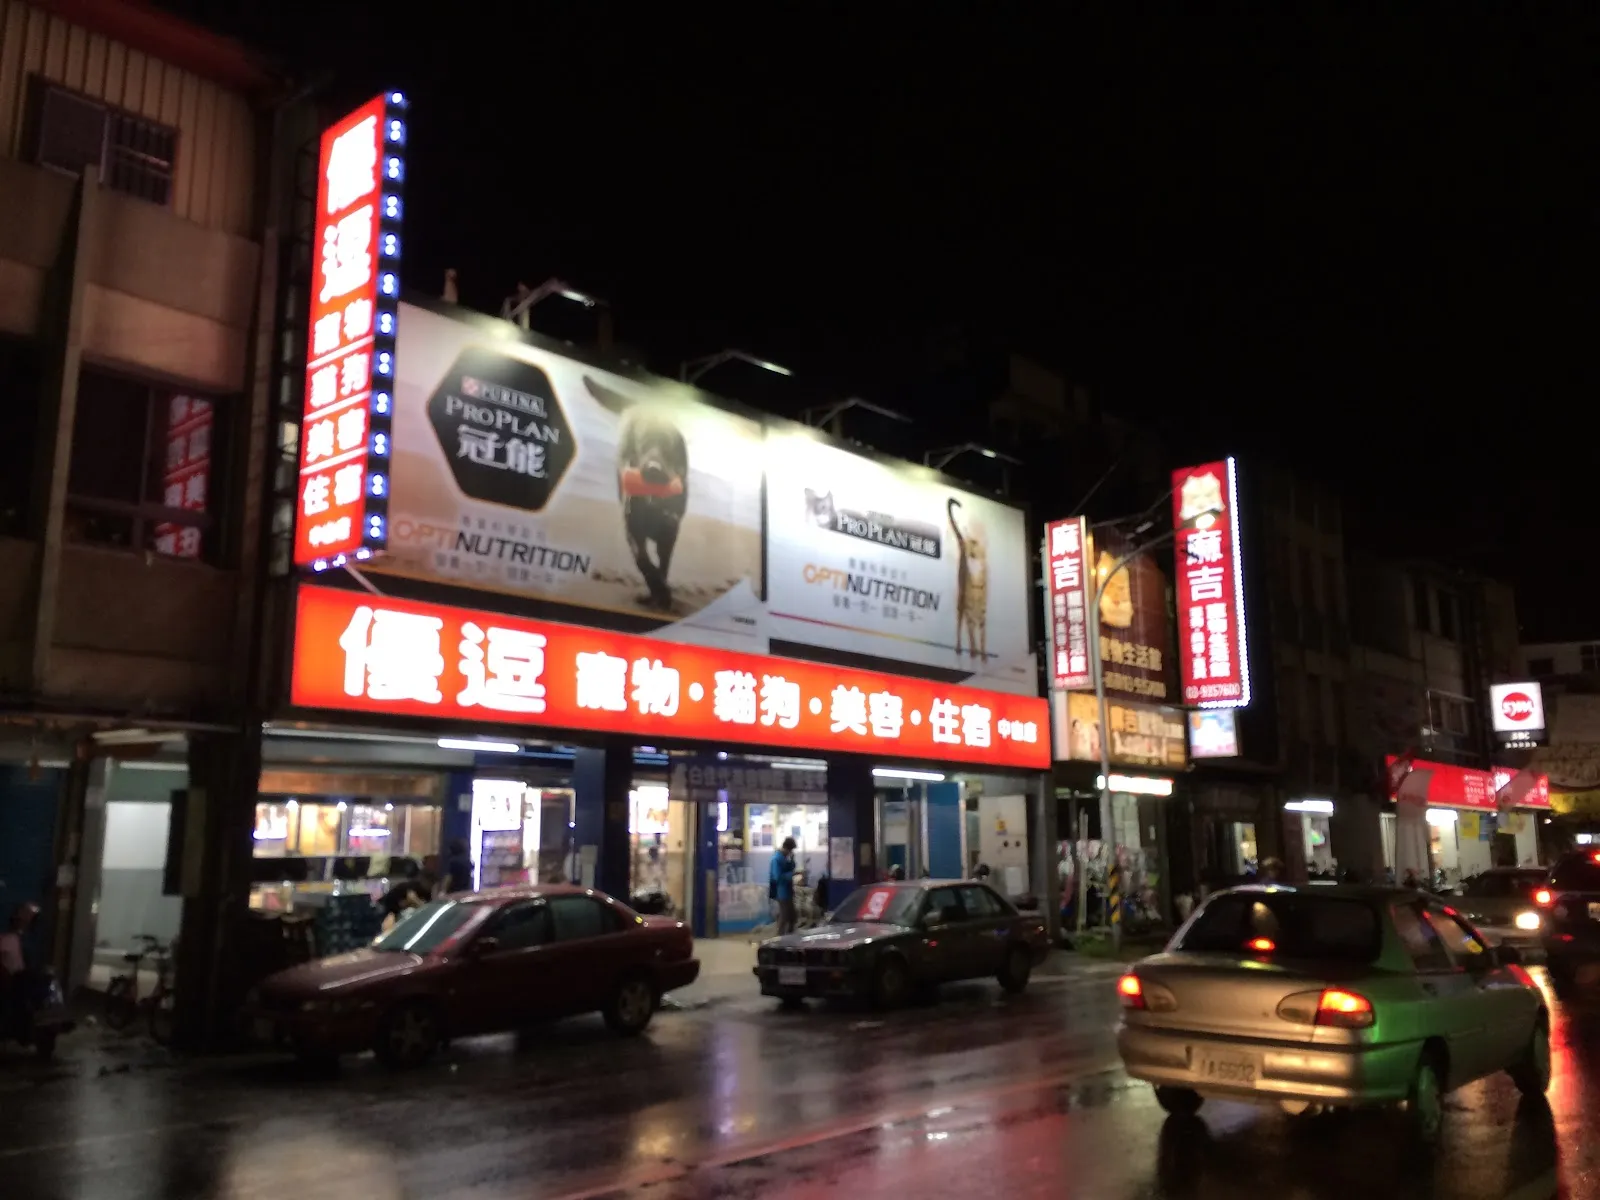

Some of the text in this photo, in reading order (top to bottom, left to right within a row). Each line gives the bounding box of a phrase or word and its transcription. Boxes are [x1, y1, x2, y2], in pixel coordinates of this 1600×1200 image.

[481, 385, 541, 414] PURINA
[456, 425, 547, 479] 冠能
[1051, 523, 1081, 590] 麻吉
